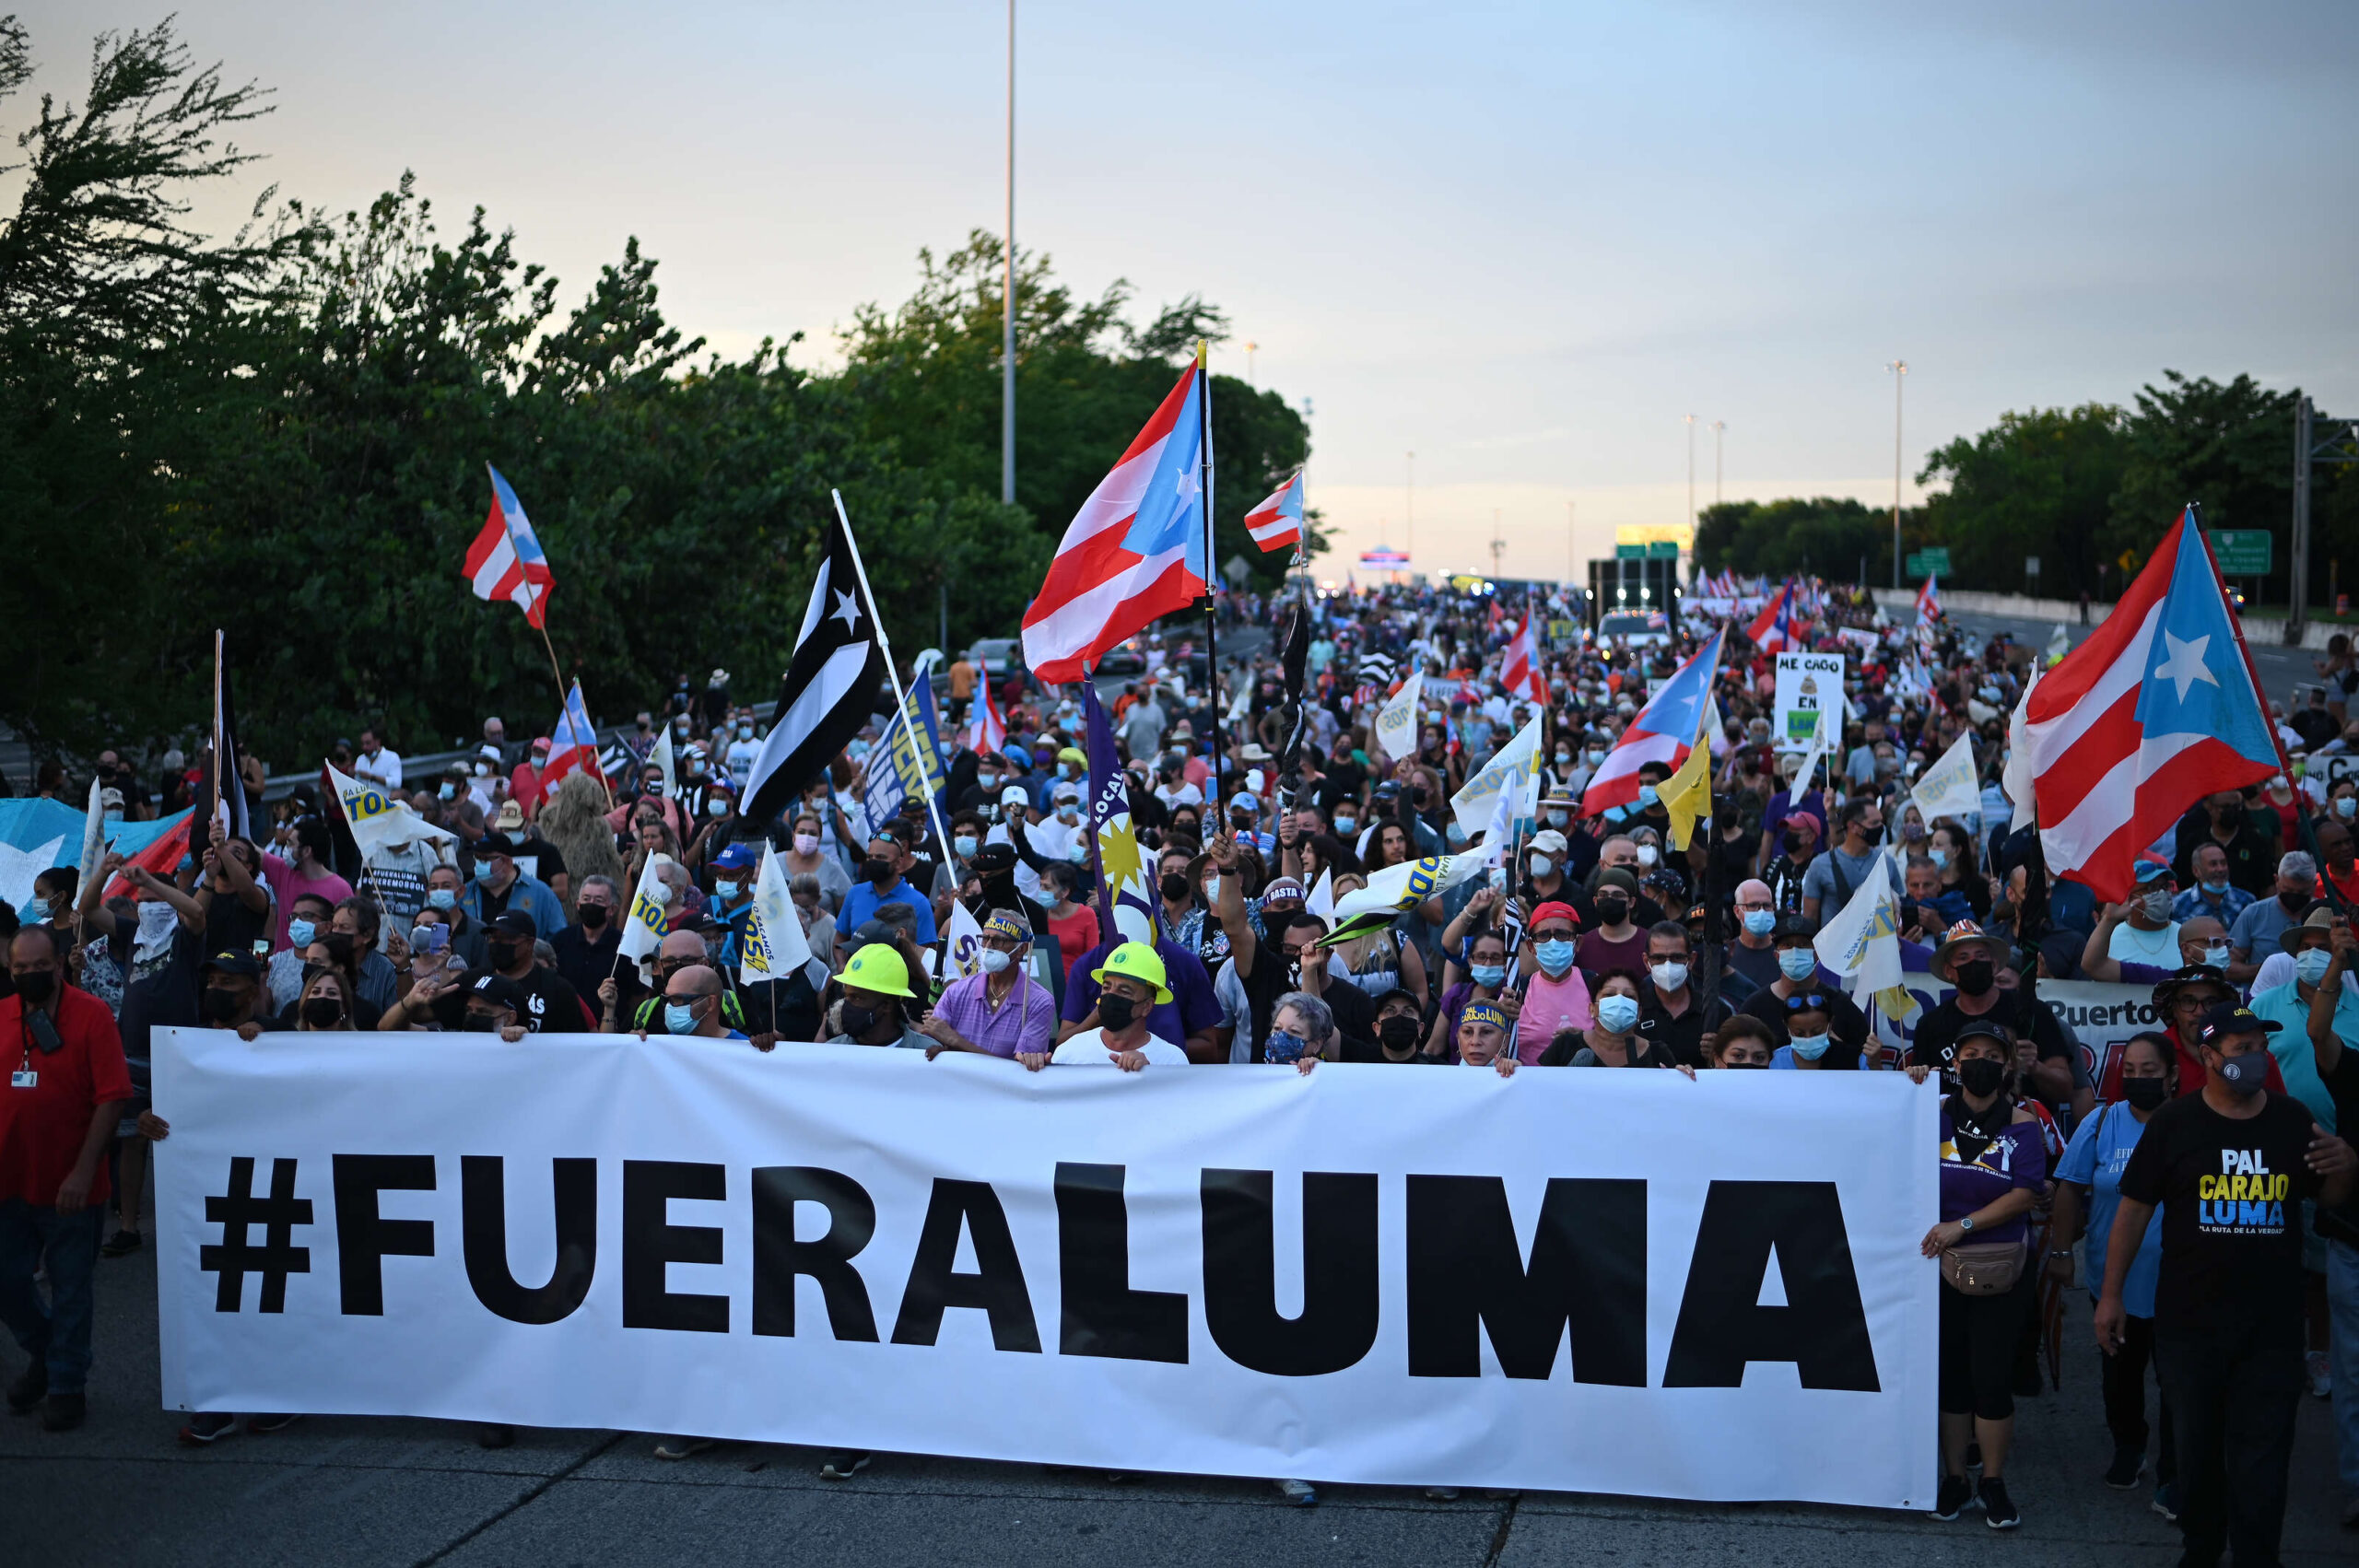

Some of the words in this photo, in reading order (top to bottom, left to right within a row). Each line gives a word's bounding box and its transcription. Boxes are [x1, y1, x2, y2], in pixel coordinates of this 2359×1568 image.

[1779, 658, 1799, 670] ME
[1804, 660, 1839, 673] CAGO
[1799, 696, 1817, 708] EN
[1095, 772, 1123, 825] LOCAL
[756, 915, 775, 961] SACAMOS
[1002, 919, 1023, 941] LUMA
[2222, 1149, 2270, 1175] PAL
[2200, 1174, 2289, 1201] CARAJO
[2200, 1199, 2285, 1226] LUMA
[200, 1153, 1882, 1392] #FUERALUMA
